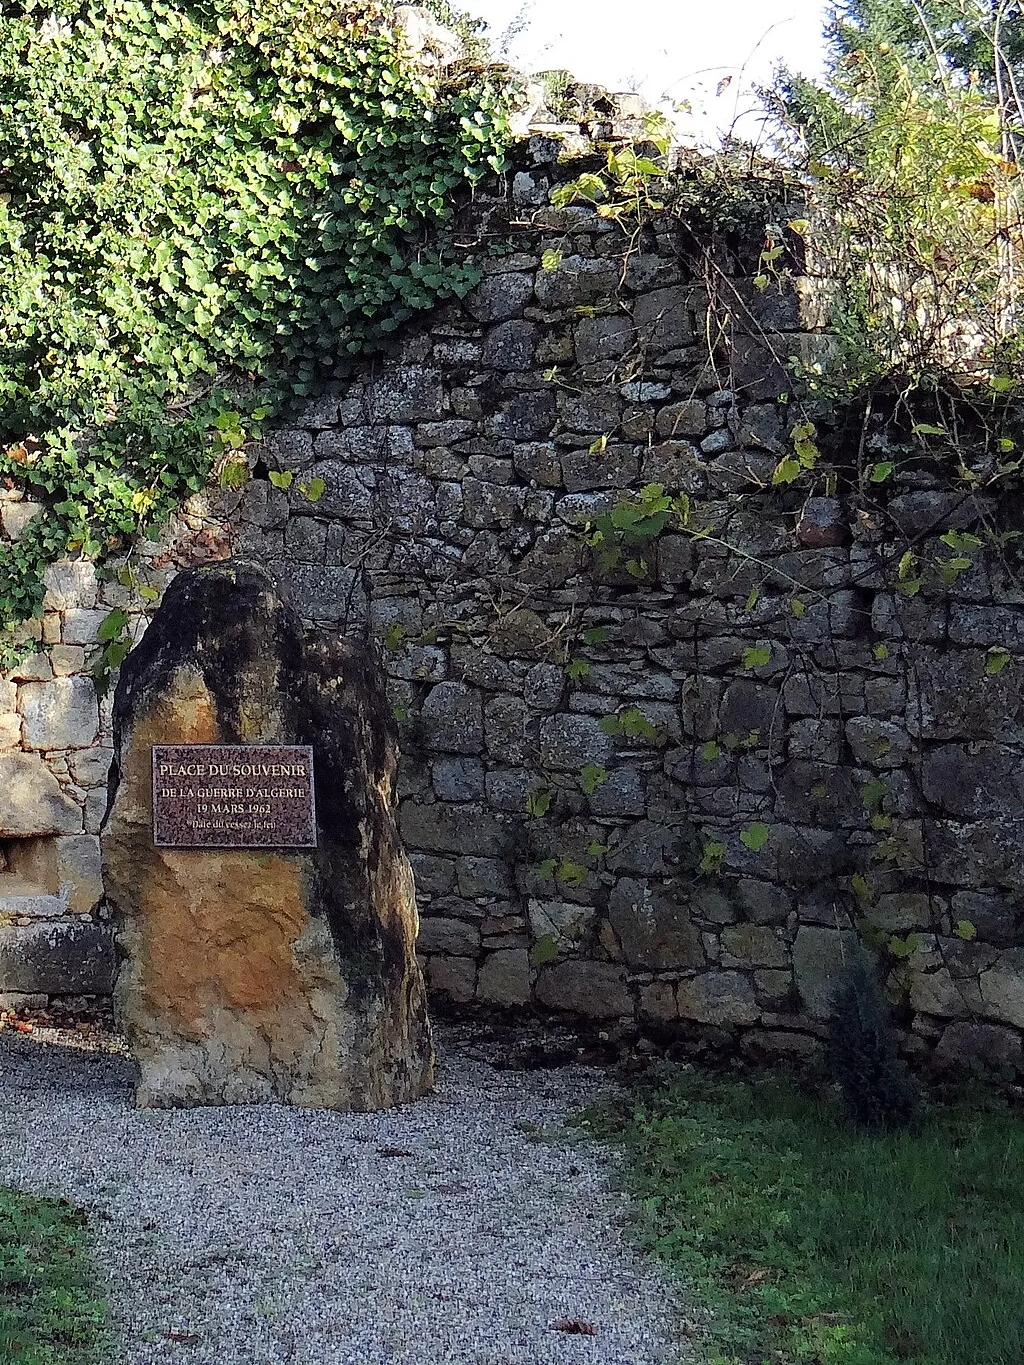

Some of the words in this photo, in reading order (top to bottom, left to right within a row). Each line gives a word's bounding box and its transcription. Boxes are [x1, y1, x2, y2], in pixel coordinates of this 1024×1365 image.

[159, 764, 205, 776] PLACE
[208, 764, 229, 776] DU
[233, 764, 307, 776] SOUVENIR
[161, 788, 177, 798] DE
[179, 788, 194, 798] LA
[197, 788, 243, 798] GUERRE
[197, 803, 208, 813] 19
[211, 803, 245, 813] MARS
[248, 803, 271, 813] 1962
